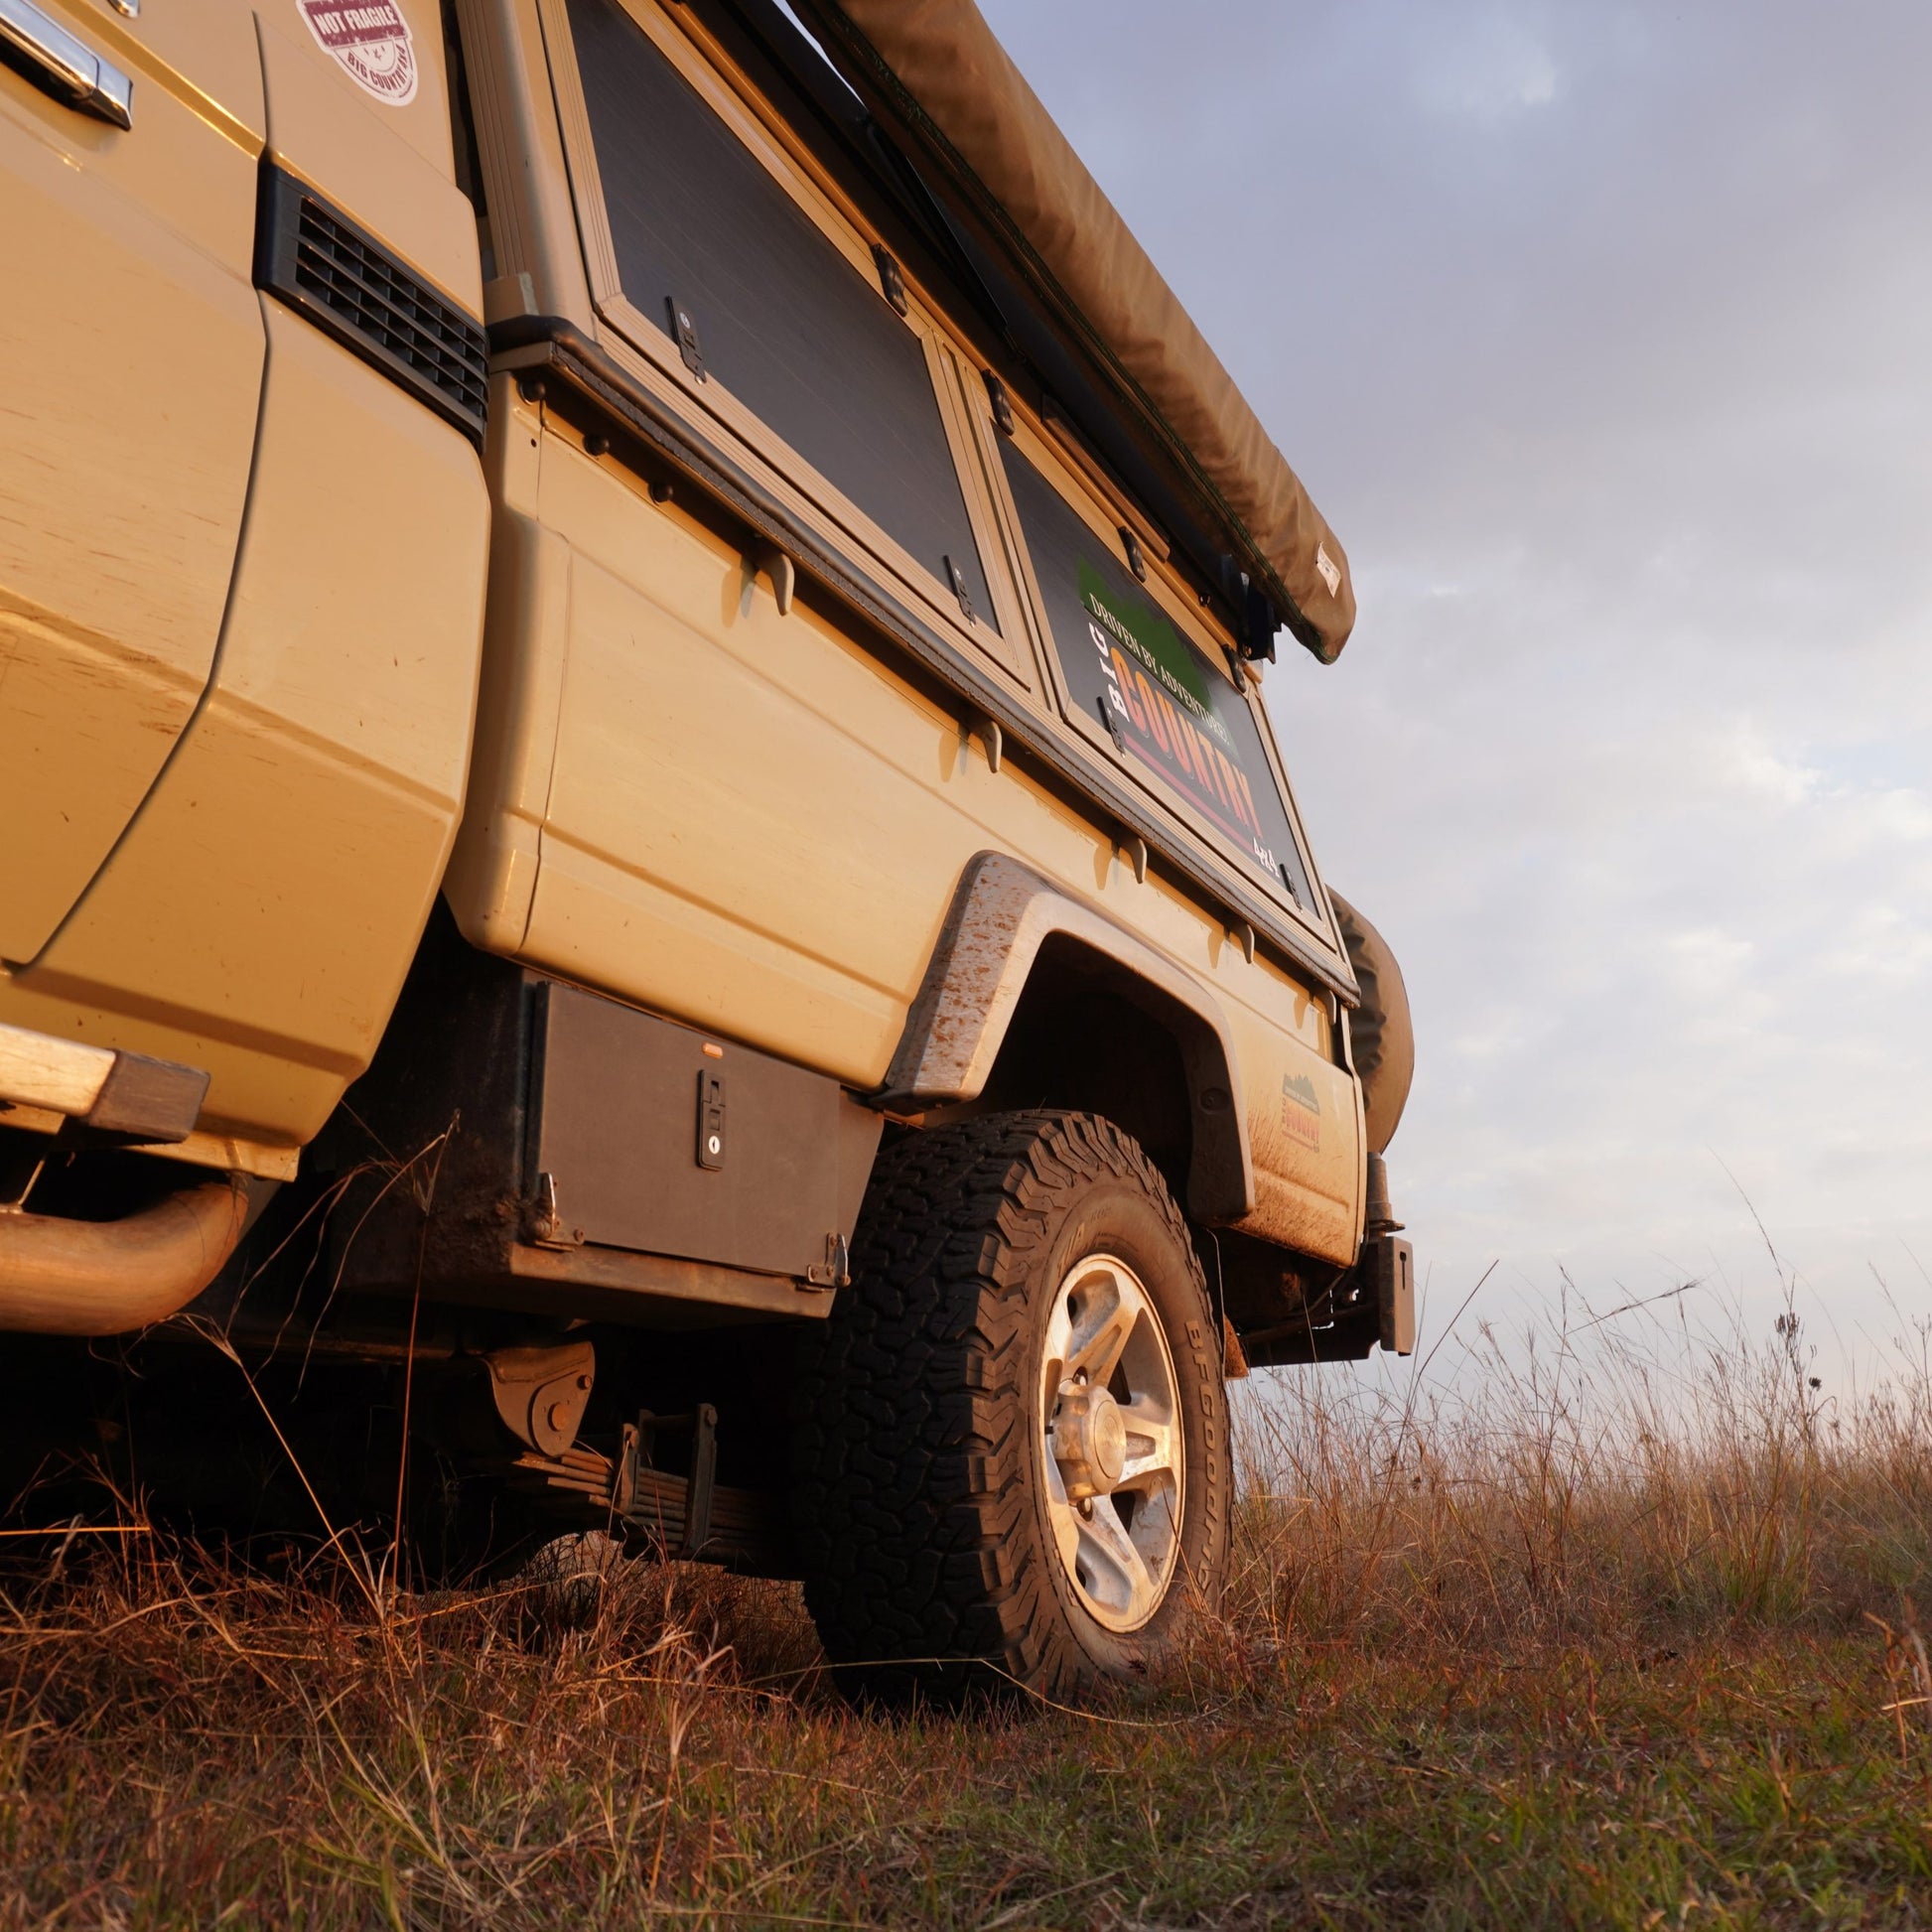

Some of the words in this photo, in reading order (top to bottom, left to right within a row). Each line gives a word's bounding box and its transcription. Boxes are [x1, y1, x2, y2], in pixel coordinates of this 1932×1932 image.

[313, 11, 347, 36] NOT
[344, 5, 399, 31] FRAGILE
[347, 51, 368, 79] BIG
[369, 64, 407, 91] COUNTRY
[1088, 592, 1142, 658] DRIVEN
[1140, 644, 1159, 674] BY
[1088, 621, 1131, 723] BIG
[1110, 646, 1262, 839] COUNTRY
